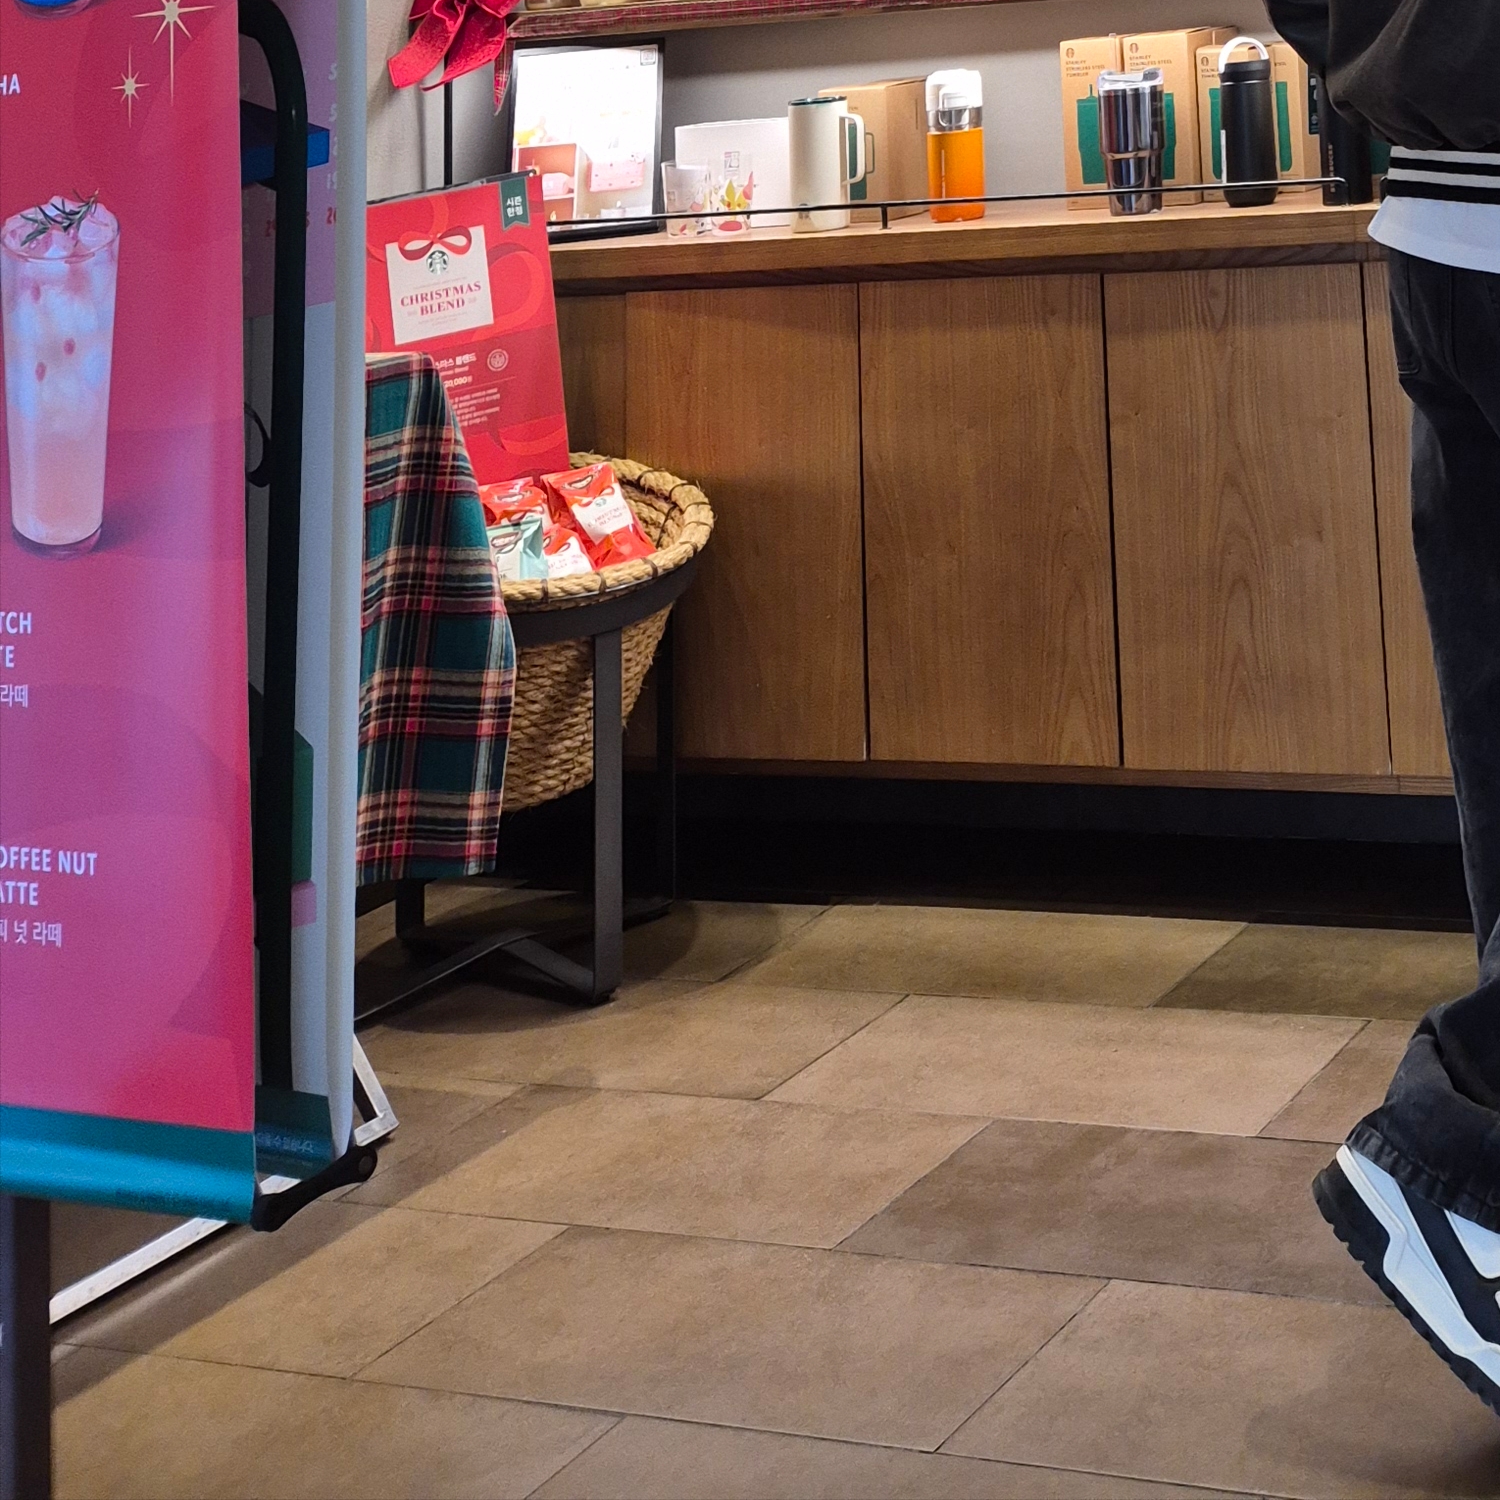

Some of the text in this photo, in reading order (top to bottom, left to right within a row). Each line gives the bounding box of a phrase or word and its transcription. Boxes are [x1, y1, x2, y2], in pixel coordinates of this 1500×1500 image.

[400, 280, 482, 307] CHRISTMAS
[420, 298, 465, 316] BLEND
[58, 849, 98, 876] NUT
[14, 920, 28, 945] 넛
[33, 921, 62, 948] 라떼
